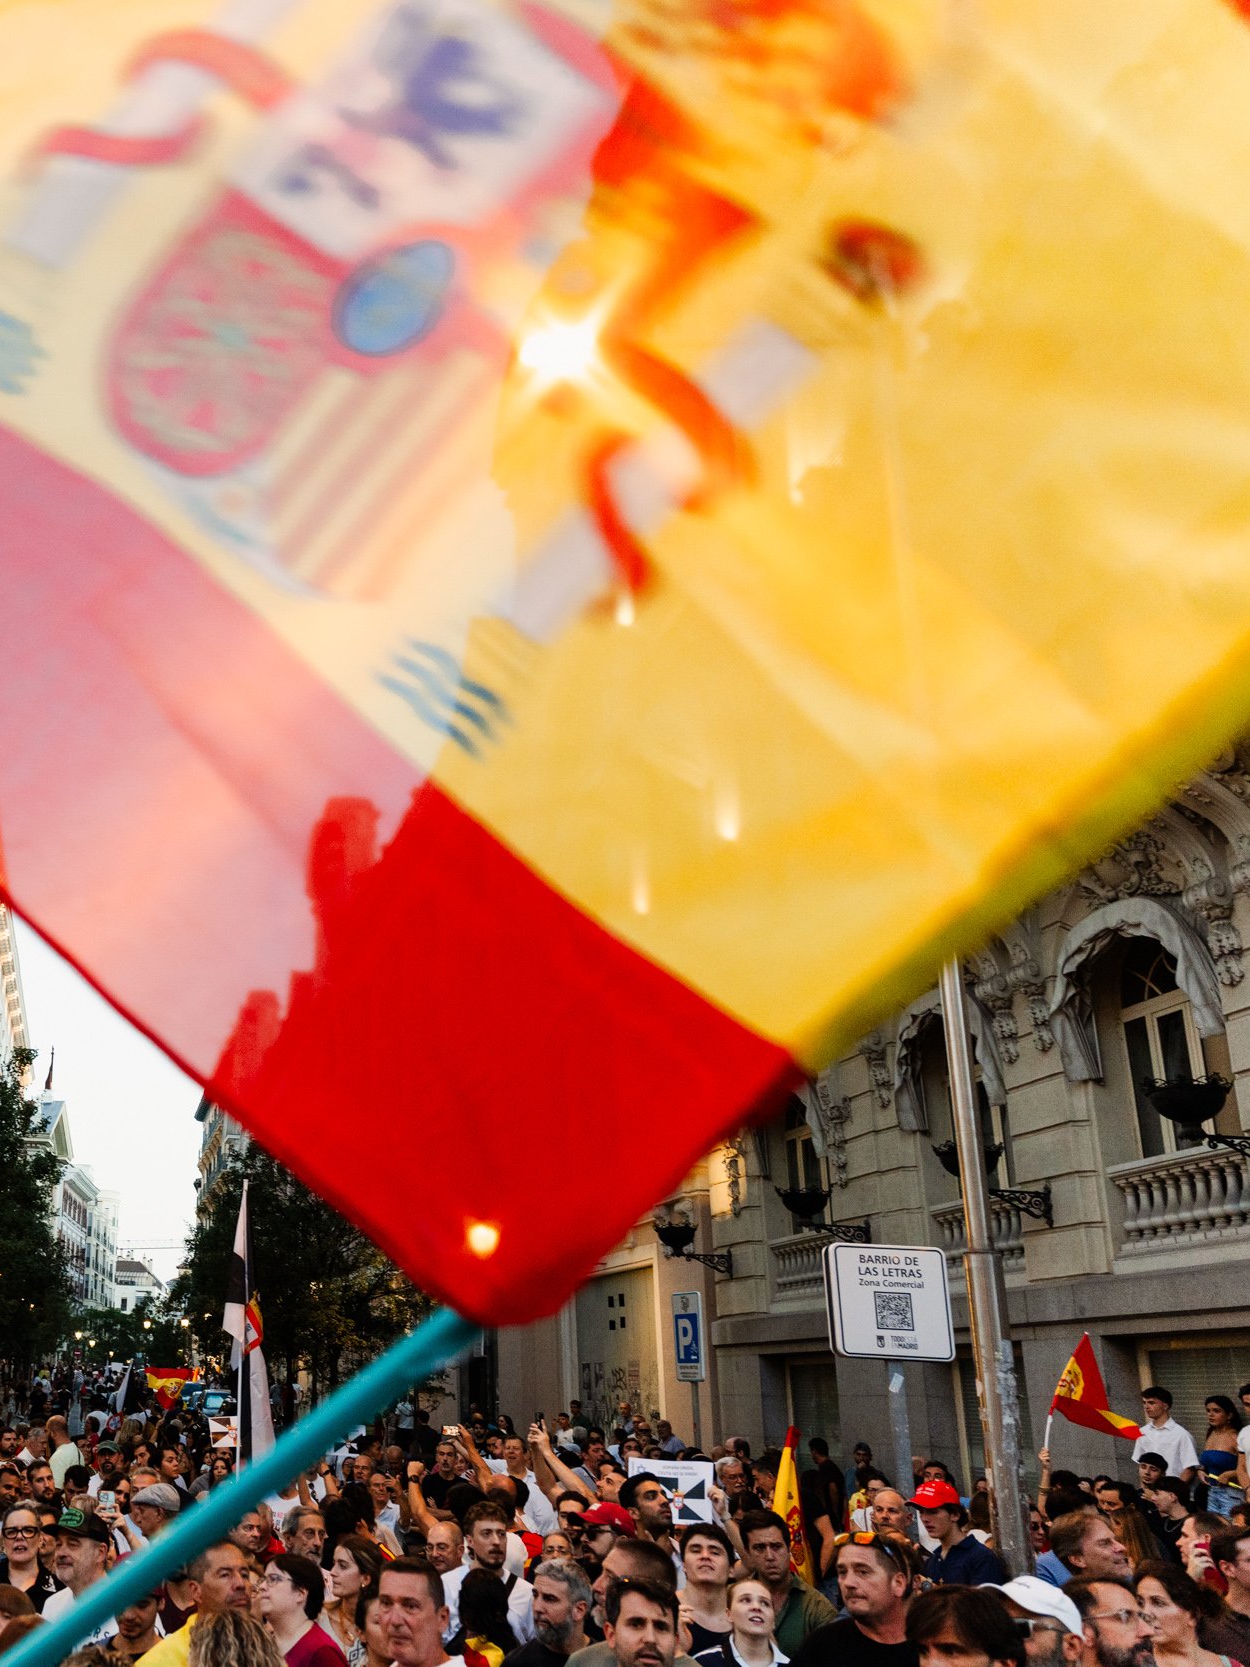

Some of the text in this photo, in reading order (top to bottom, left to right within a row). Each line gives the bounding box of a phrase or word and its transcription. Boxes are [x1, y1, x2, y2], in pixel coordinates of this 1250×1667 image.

[859, 1254, 919, 1266] BARRIO DE
[858, 1266, 922, 1278] LAS LETRAS
[858, 1278, 925, 1289] Zona Comercial
[677, 1318, 693, 1360] P
